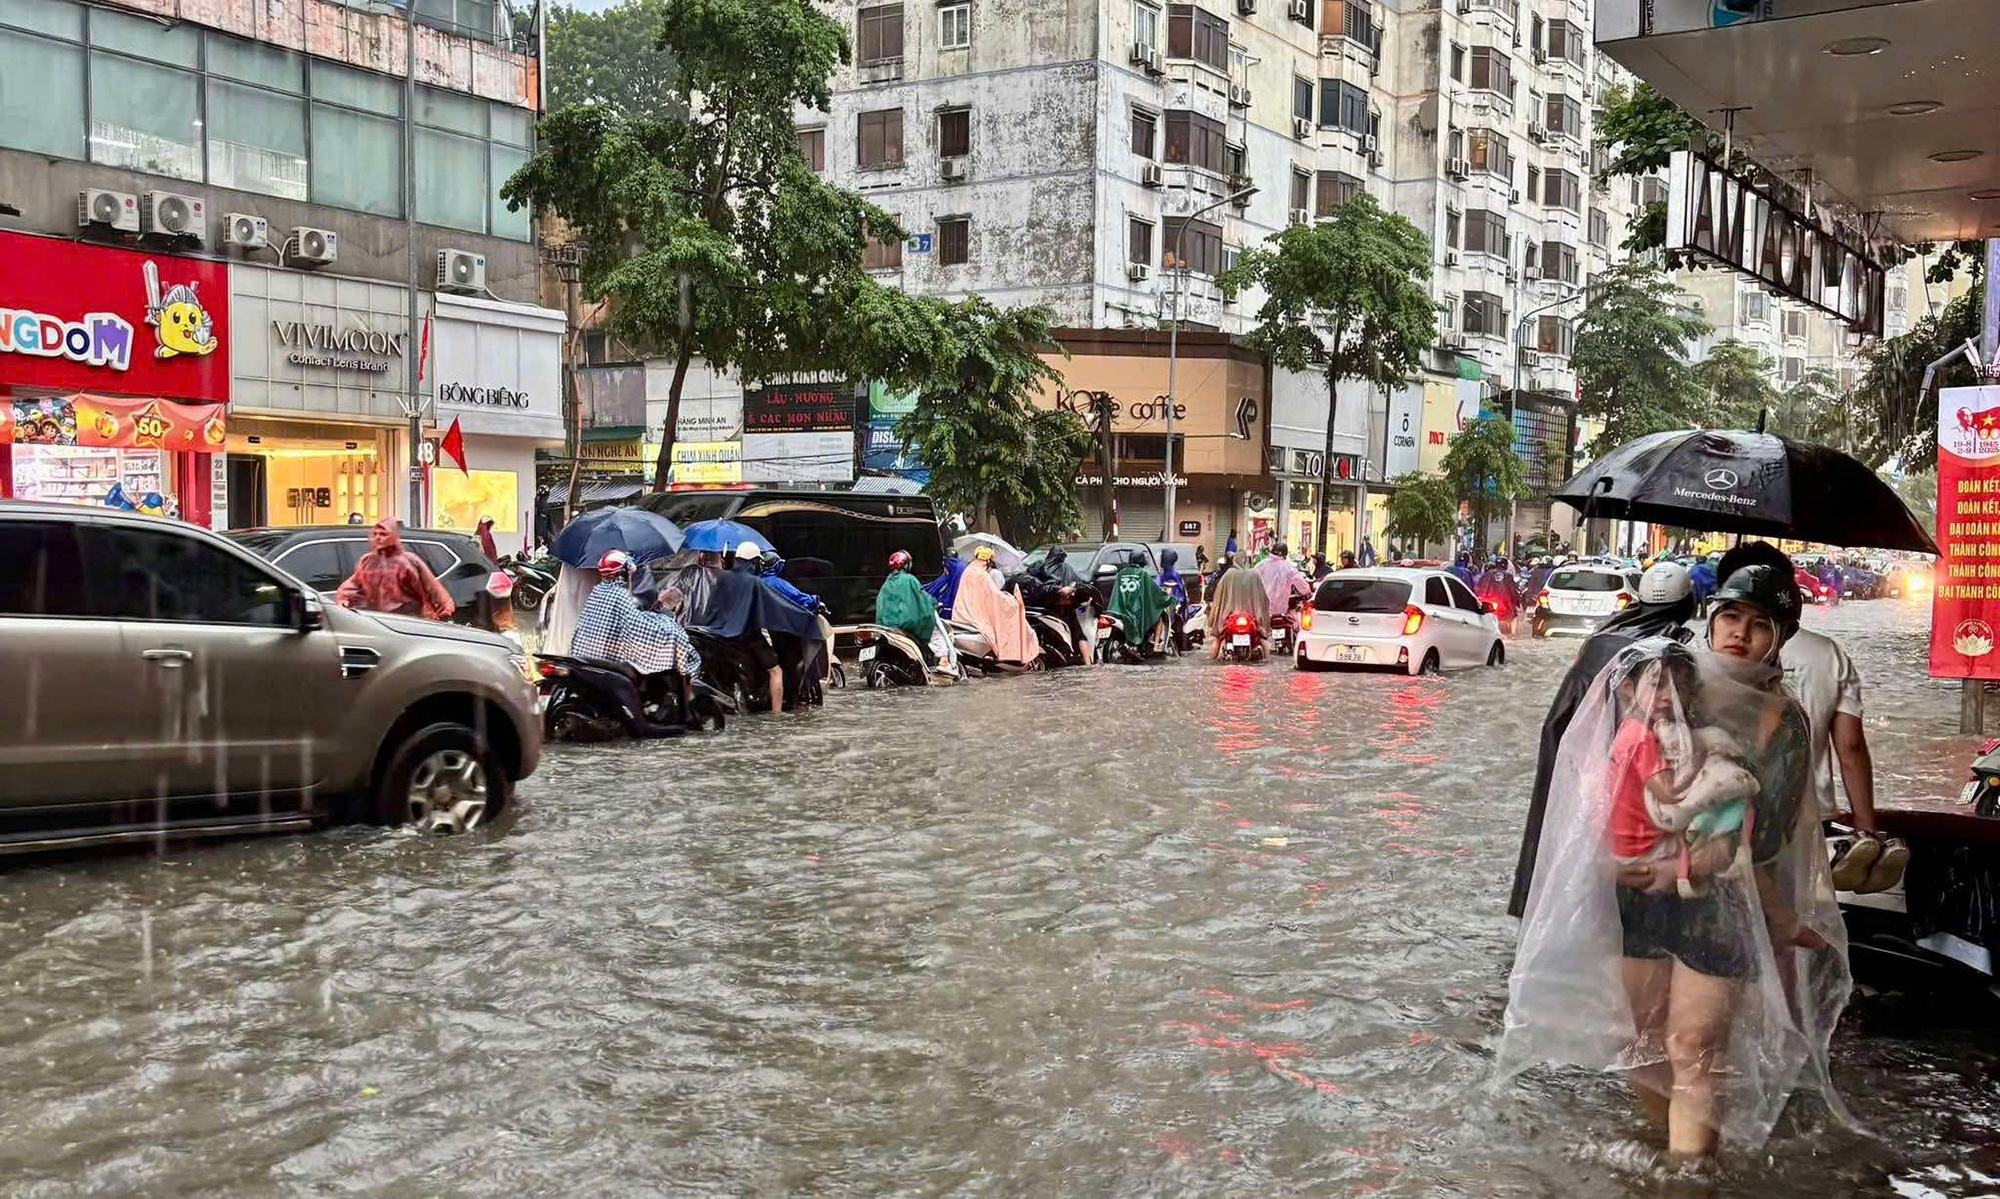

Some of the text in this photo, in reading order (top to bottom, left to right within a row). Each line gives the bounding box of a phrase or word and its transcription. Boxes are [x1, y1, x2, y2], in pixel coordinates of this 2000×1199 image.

[273, 320, 403, 359] VIVIMOON
[289, 352, 391, 373] Contact Lens Brand
[793, 368, 819, 384] XINH
[440, 381, 530, 409] BÔNG BIÊNG
[715, 414, 727, 425] AN
[625, 445, 638, 457] AN
[1674, 487, 1758, 507] Mercedes-Benz
